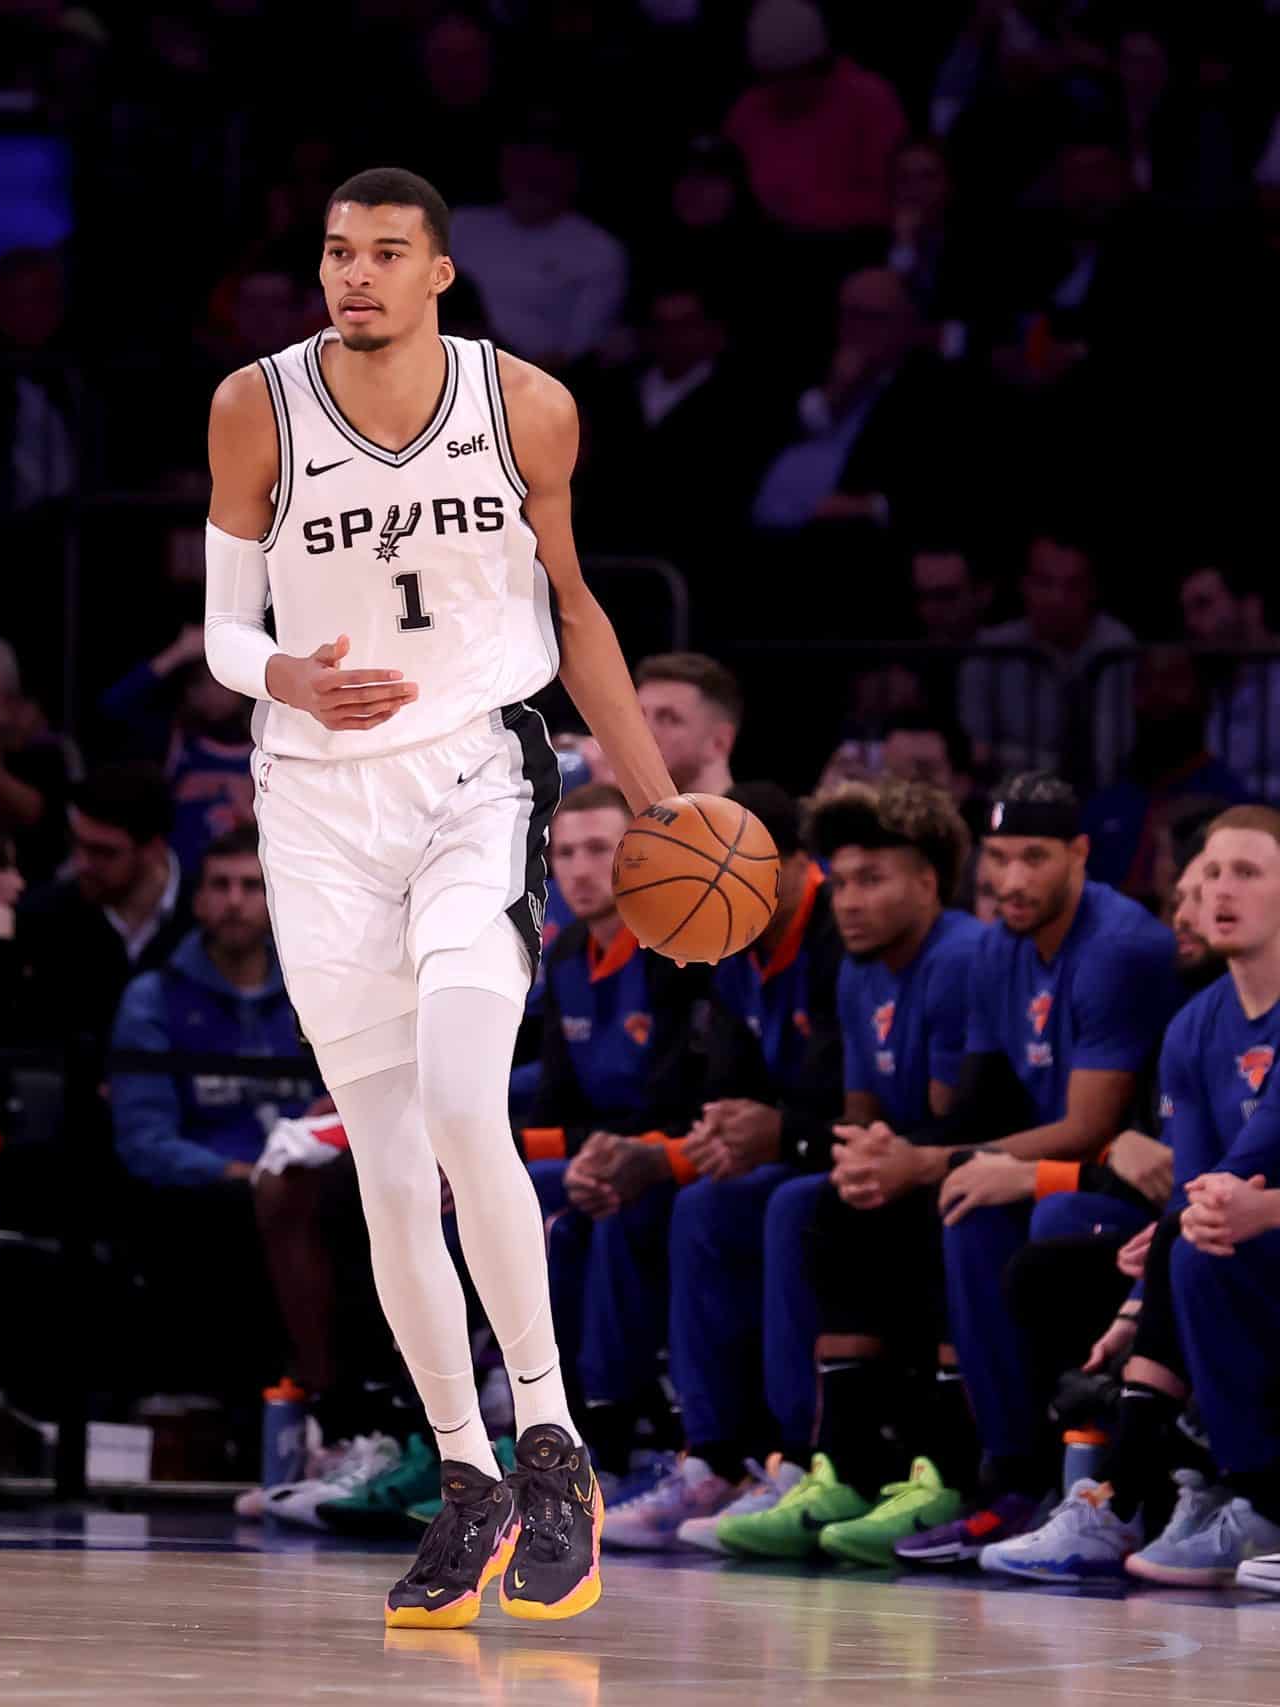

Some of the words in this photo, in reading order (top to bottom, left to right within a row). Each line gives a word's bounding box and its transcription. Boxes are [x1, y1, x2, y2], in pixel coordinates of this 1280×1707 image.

[446, 433, 489, 458] Self.
[302, 496, 505, 563] SPURS
[391, 569, 435, 633] 1
